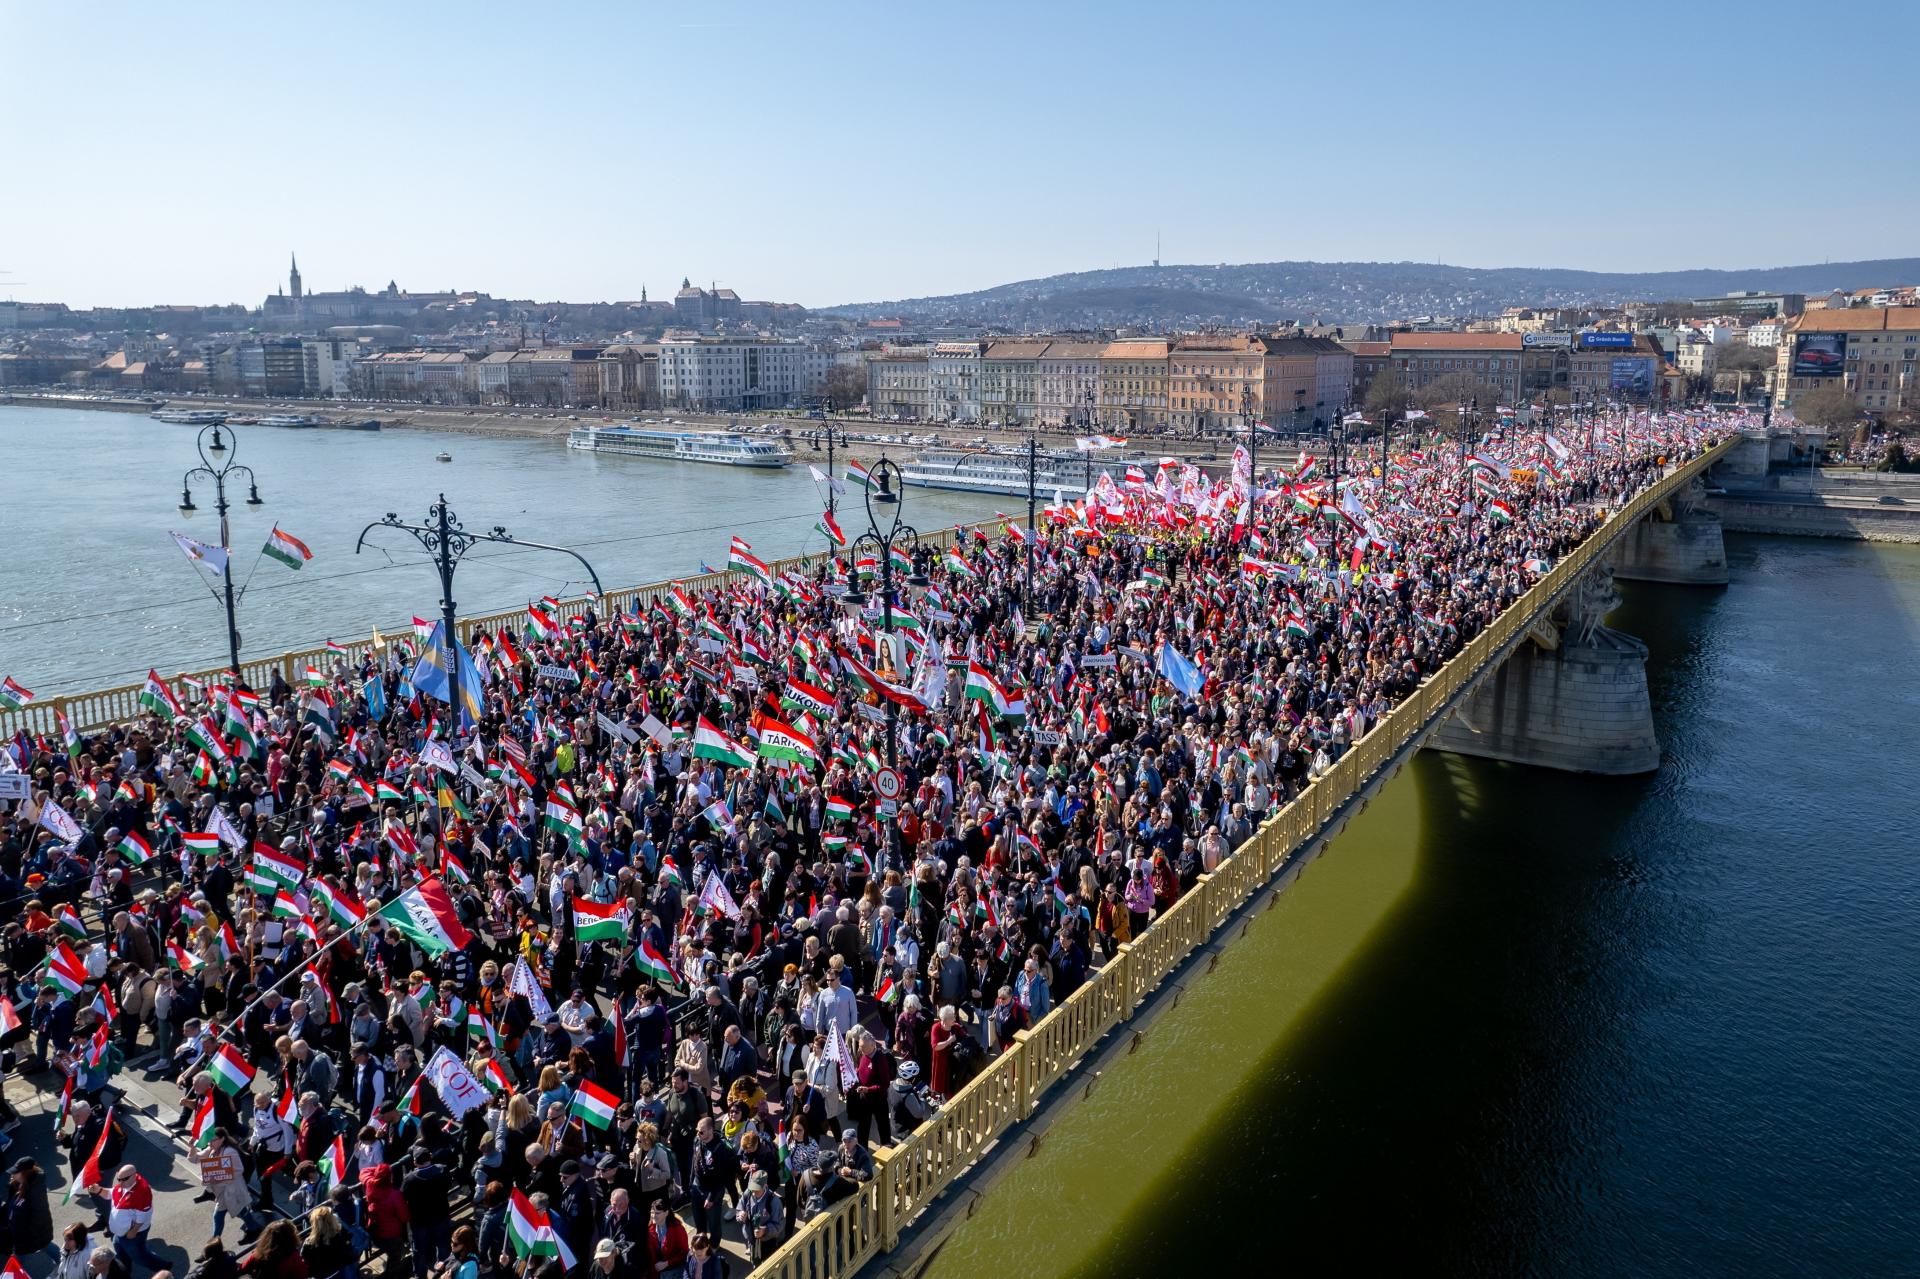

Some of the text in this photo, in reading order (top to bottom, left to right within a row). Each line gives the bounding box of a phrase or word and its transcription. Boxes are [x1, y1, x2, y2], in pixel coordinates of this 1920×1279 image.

[1533, 335, 1570, 344] goldtresor
[1807, 334, 1835, 342] Hybrid+
[202, 729, 216, 751] TATA
[1035, 732, 1058, 743] TASS
[881, 777, 894, 791] 40
